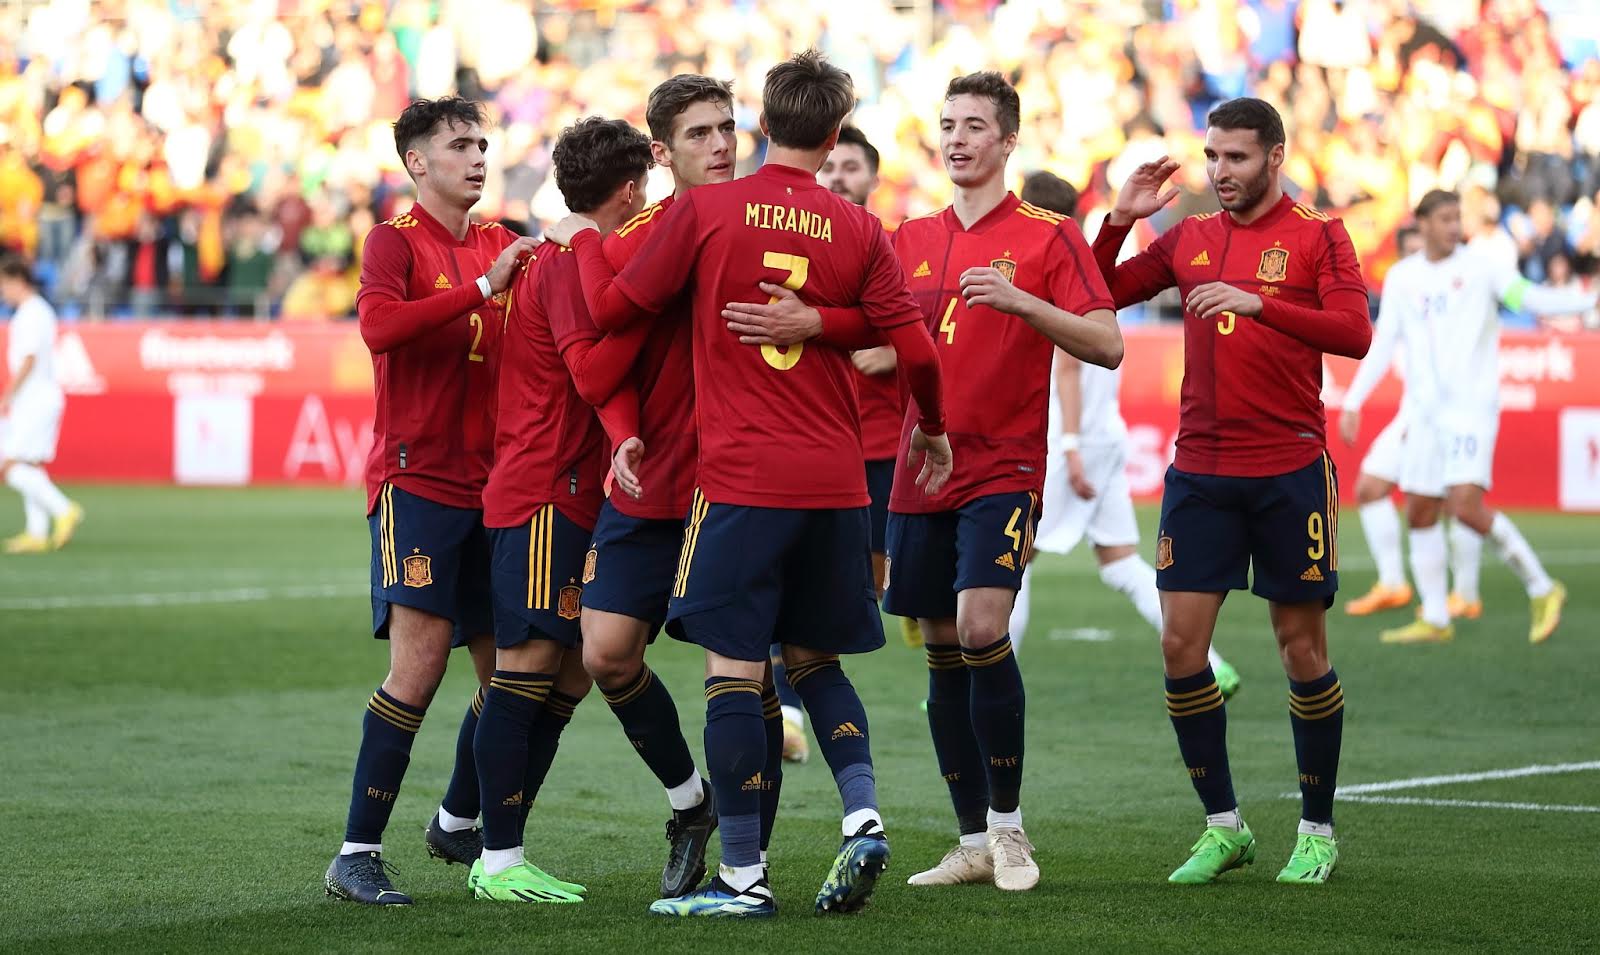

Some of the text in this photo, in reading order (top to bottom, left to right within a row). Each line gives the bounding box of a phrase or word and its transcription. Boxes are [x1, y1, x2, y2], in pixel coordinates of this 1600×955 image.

[745, 202, 832, 243] MIRANDA
[468, 312, 484, 362] 2
[939, 297, 958, 344] 4
[1004, 506, 1022, 551] 4
[1307, 511, 1325, 561] 9
